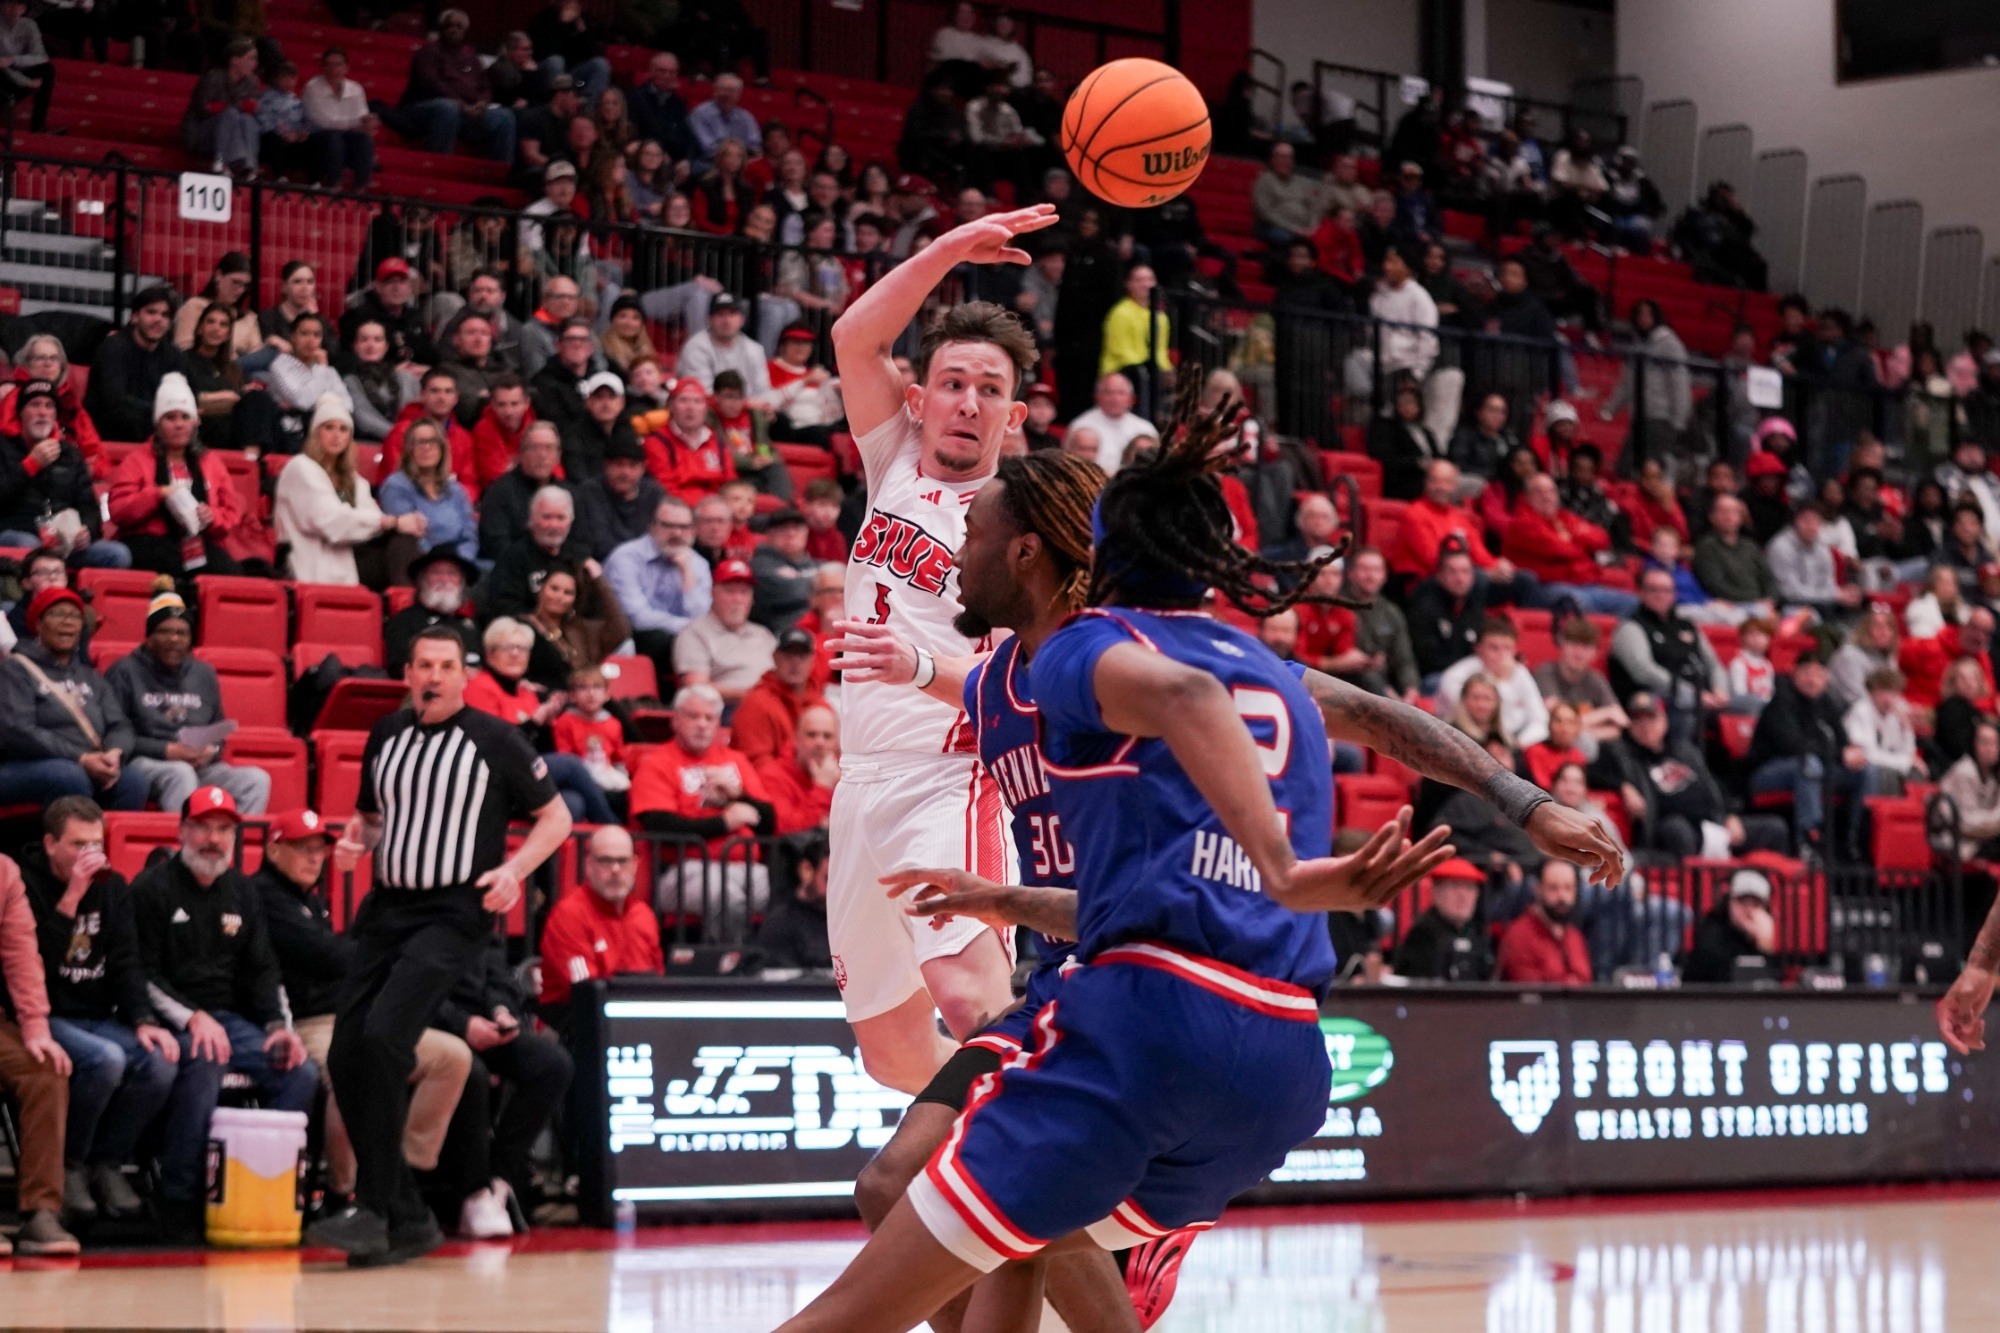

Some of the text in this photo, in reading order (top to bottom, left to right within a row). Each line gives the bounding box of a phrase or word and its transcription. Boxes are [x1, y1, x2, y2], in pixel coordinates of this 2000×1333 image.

[186, 184, 226, 212] 110
[853, 507, 955, 598] SIUE
[1029, 813, 1077, 877] 30
[606, 1043, 656, 1153] THE
[1571, 1039, 1949, 1098] FRONT OFFICE
[1575, 1101, 1869, 1140] WEALTH STRATEGIES
